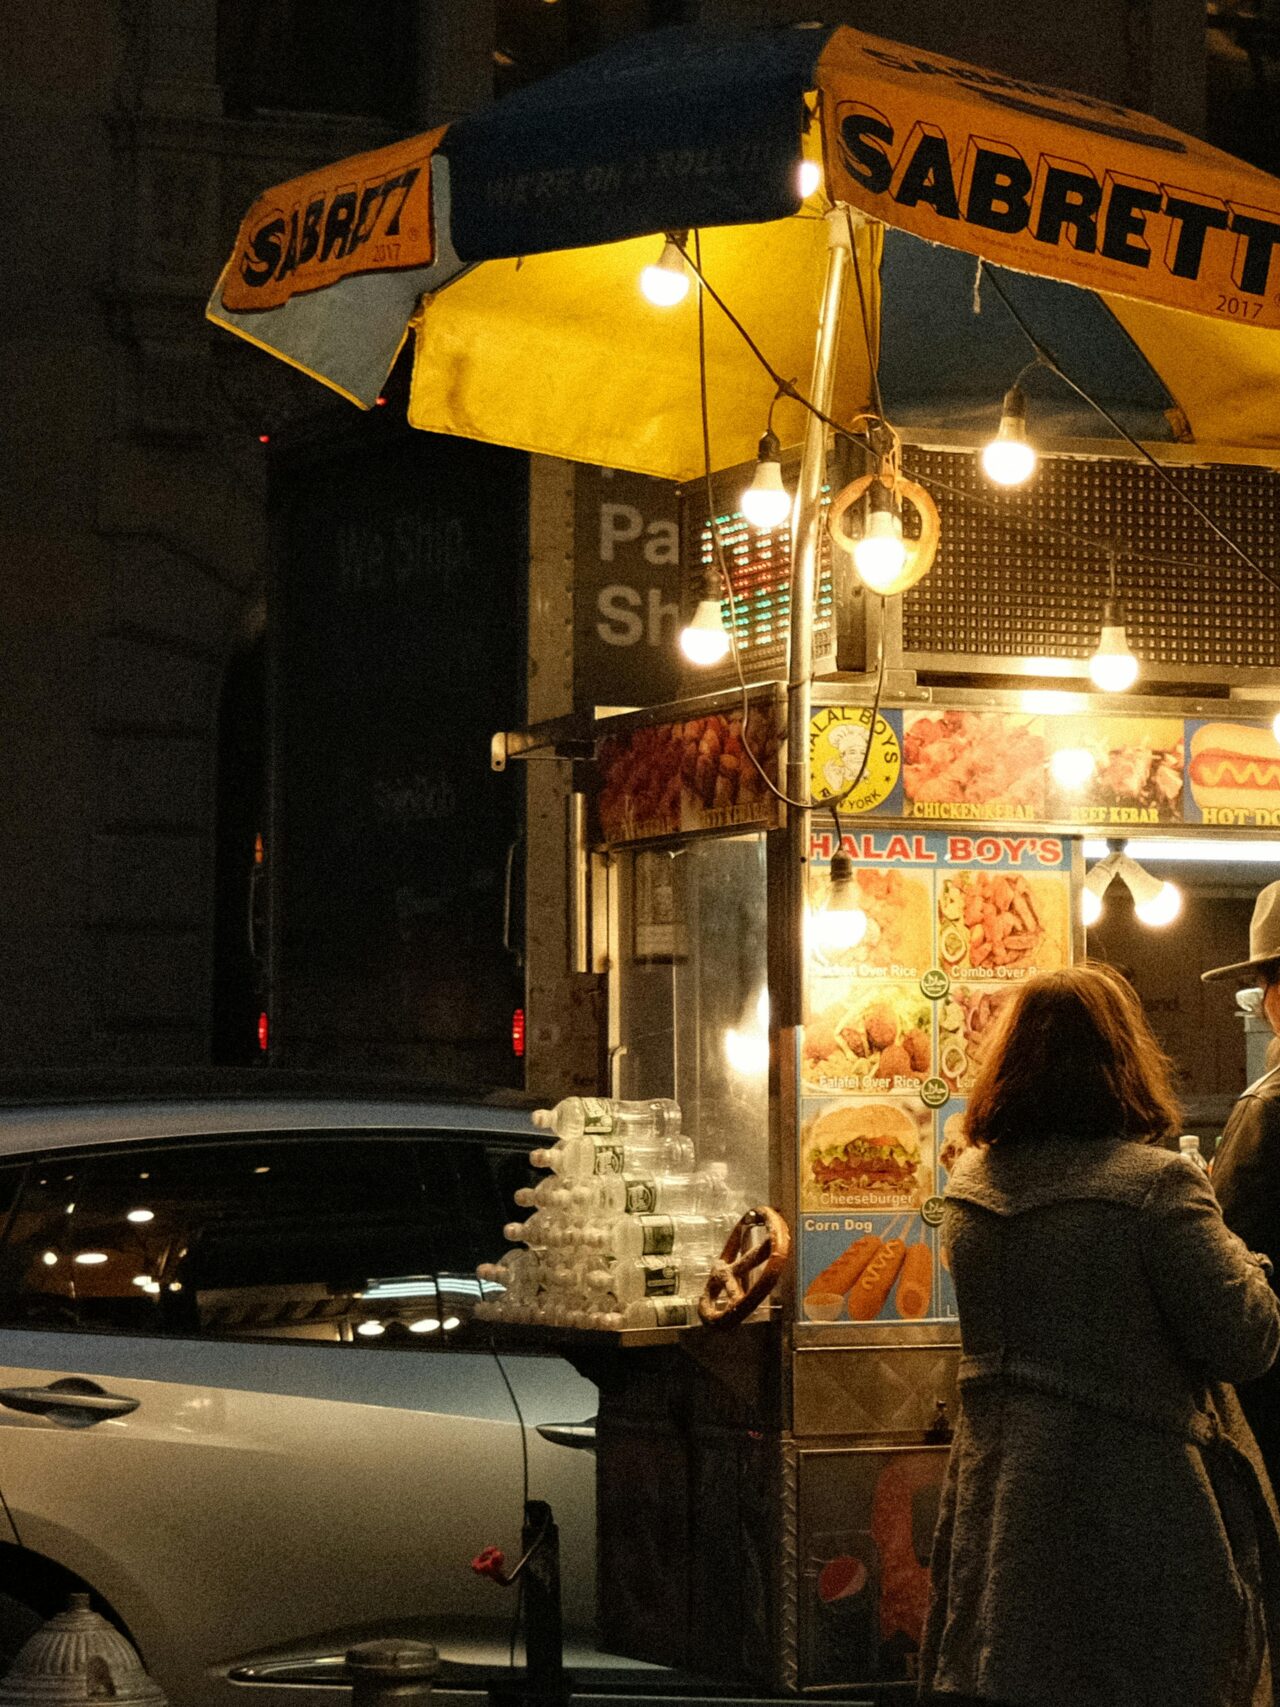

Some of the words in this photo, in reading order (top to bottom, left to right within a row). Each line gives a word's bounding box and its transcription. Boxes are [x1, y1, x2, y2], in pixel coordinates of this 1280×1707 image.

[1215, 293, 1265, 320] 2017
[599, 502, 681, 566] Pa
[810, 706, 853, 761] ALAL
[858, 707, 899, 764] BOYS
[846, 788, 882, 810] YORK
[913, 802, 980, 819] CHICKEN
[983, 802, 1035, 819] KEBAB
[1110, 807, 1160, 824] KEBAB
[1201, 807, 1242, 826] HOT
[810, 834, 935, 863] HALAL
[948, 836, 1064, 864] BOY'S
[891, 965, 917, 977] Rice
[951, 966, 994, 977] Combo
[997, 966, 1025, 977] Over
[862, 1075, 892, 1088] Over
[894, 1075, 920, 1088] Rice
[819, 1193, 914, 1206] Cheeseburger
[804, 1220, 840, 1231] Corn
[844, 1219, 873, 1233] Dog
